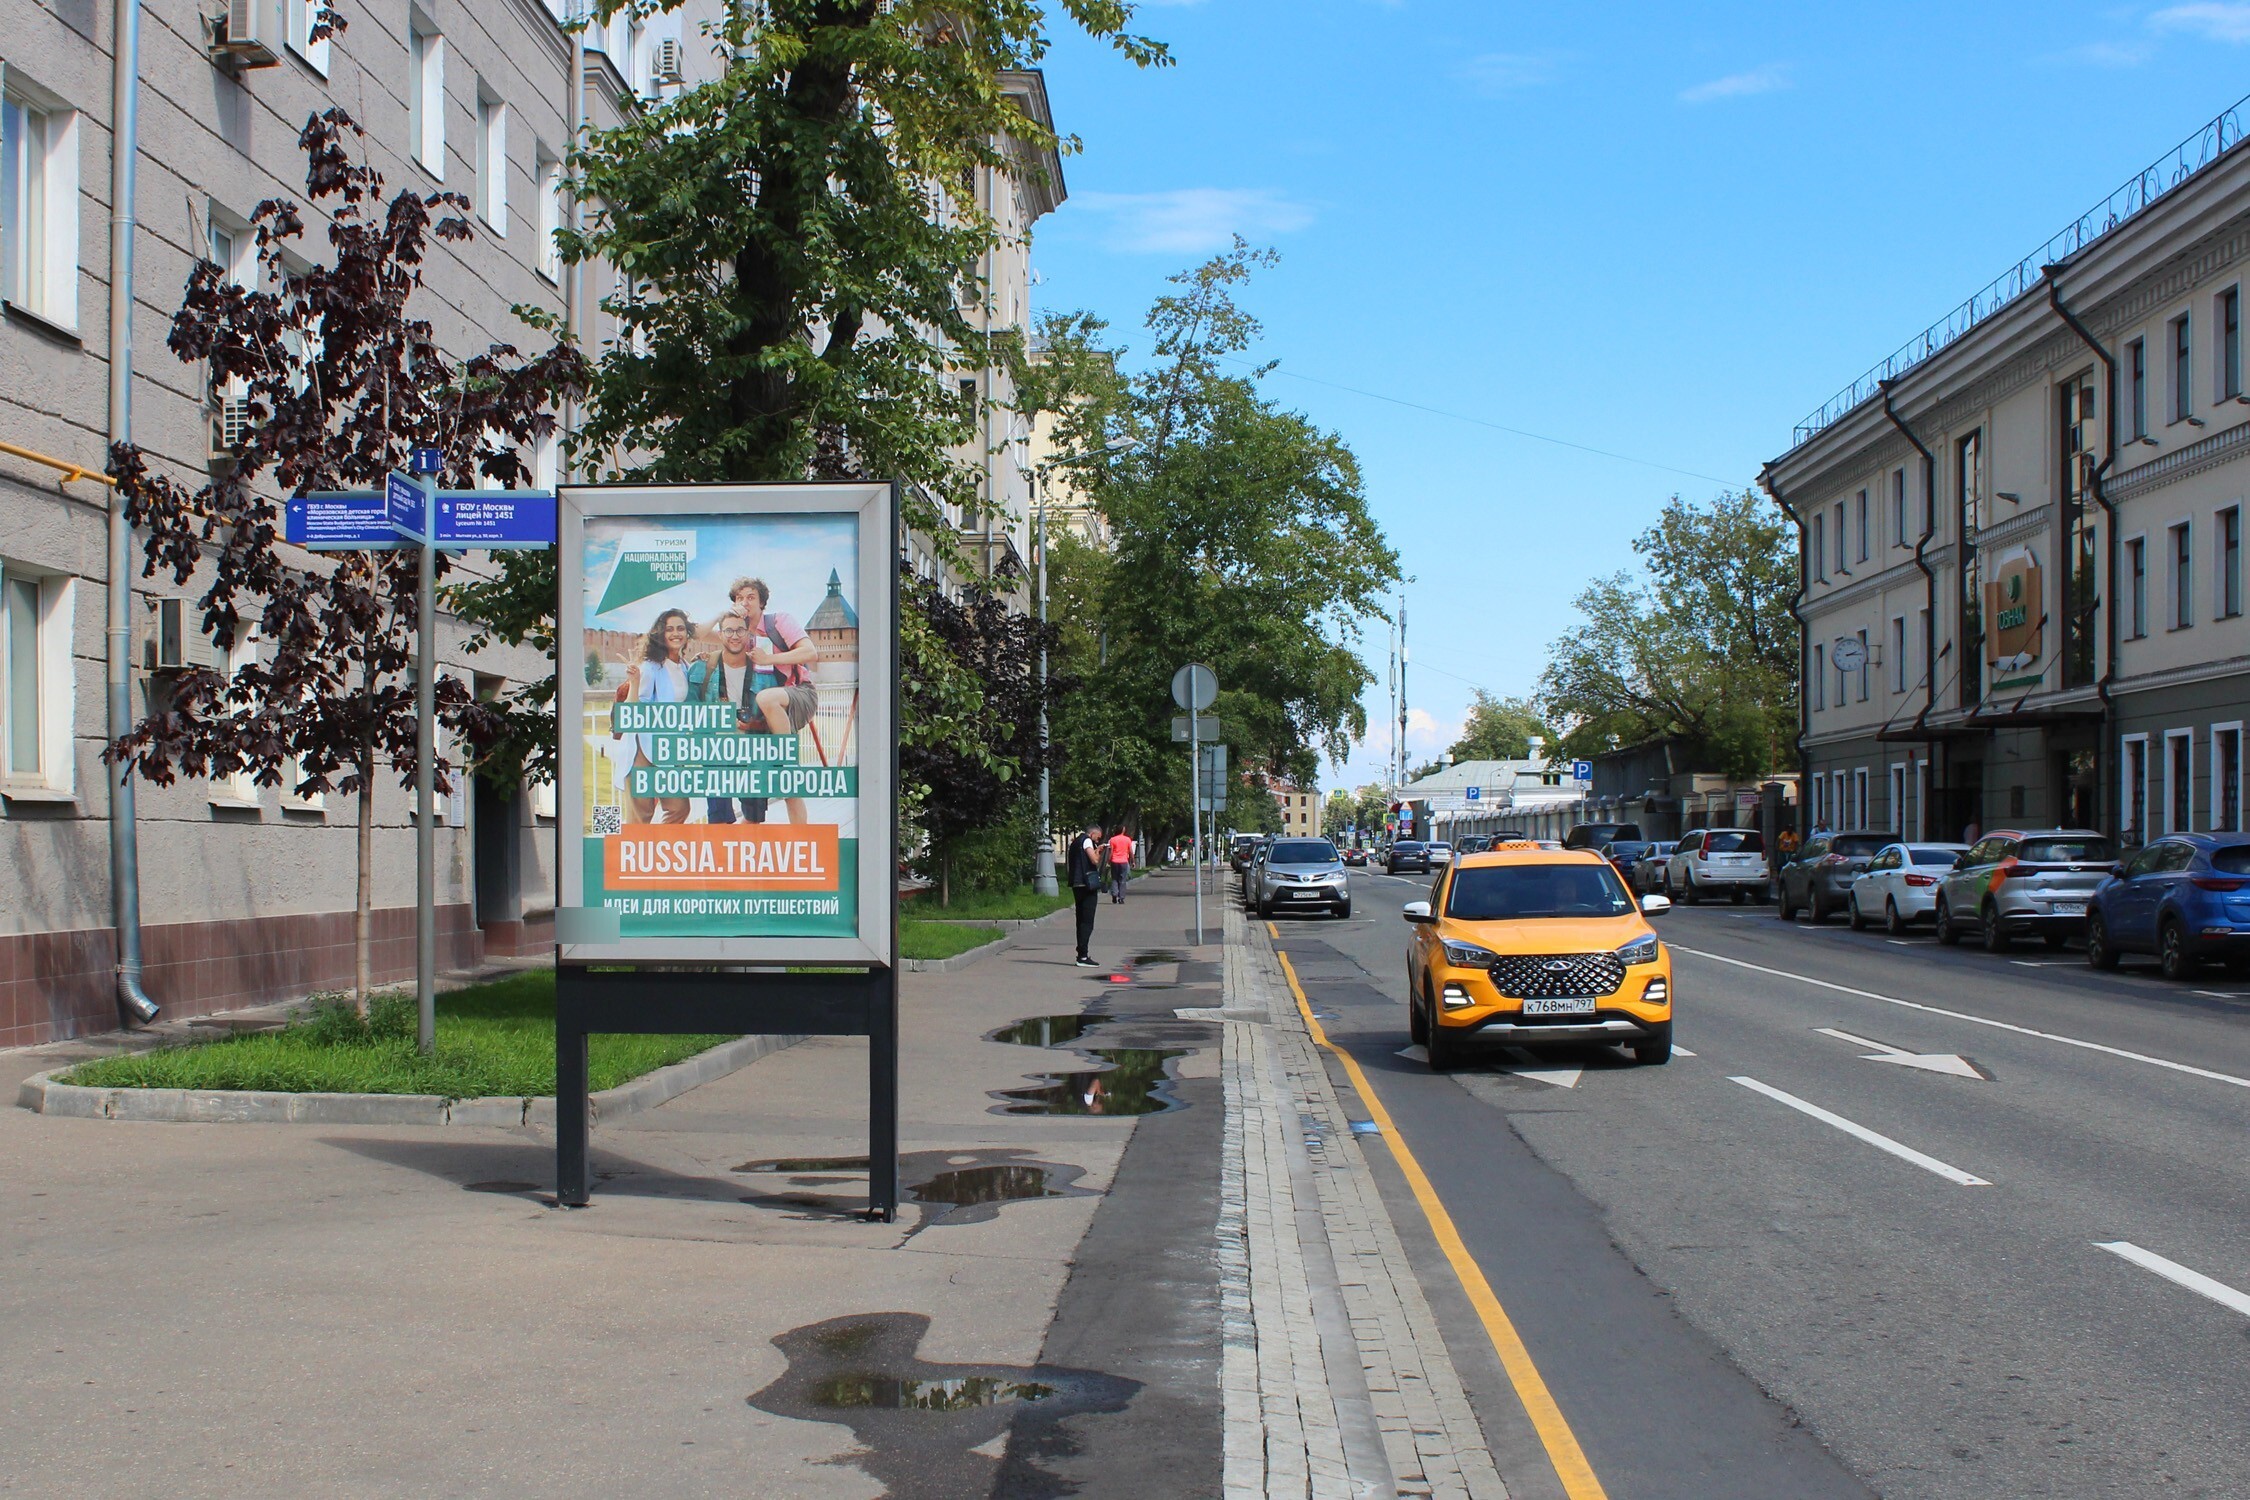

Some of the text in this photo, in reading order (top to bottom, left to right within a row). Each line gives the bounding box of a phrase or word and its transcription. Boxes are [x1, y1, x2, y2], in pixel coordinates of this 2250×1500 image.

[456, 503, 476, 511] ГБОУ
[482, 503, 514, 511] Москвы
[456, 511, 481, 519] лицей
[624, 552, 685, 564] НАЦИОНАЛЬНЫЕ
[650, 562, 685, 572] ПРОЕКТЫ
[656, 572, 685, 581] РОССИИ
[619, 704, 732, 731] ВЫХОДИТЕ
[657, 737, 796, 764] В ВЫХОДНЫЕ
[1578, 763, 1589, 778] P
[636, 770, 848, 797] В СОСЕДНИЕ ГОРОДА
[1469, 788, 1477, 798] P
[620, 840, 825, 873] RUSSIA.TRAVEL
[604, 896, 839, 916] ИДЕИ ДЛЯ КОРОТКИХ ПУТЕШЕСТВИЙ
[1527, 999, 1592, 1013] К768МН 797
